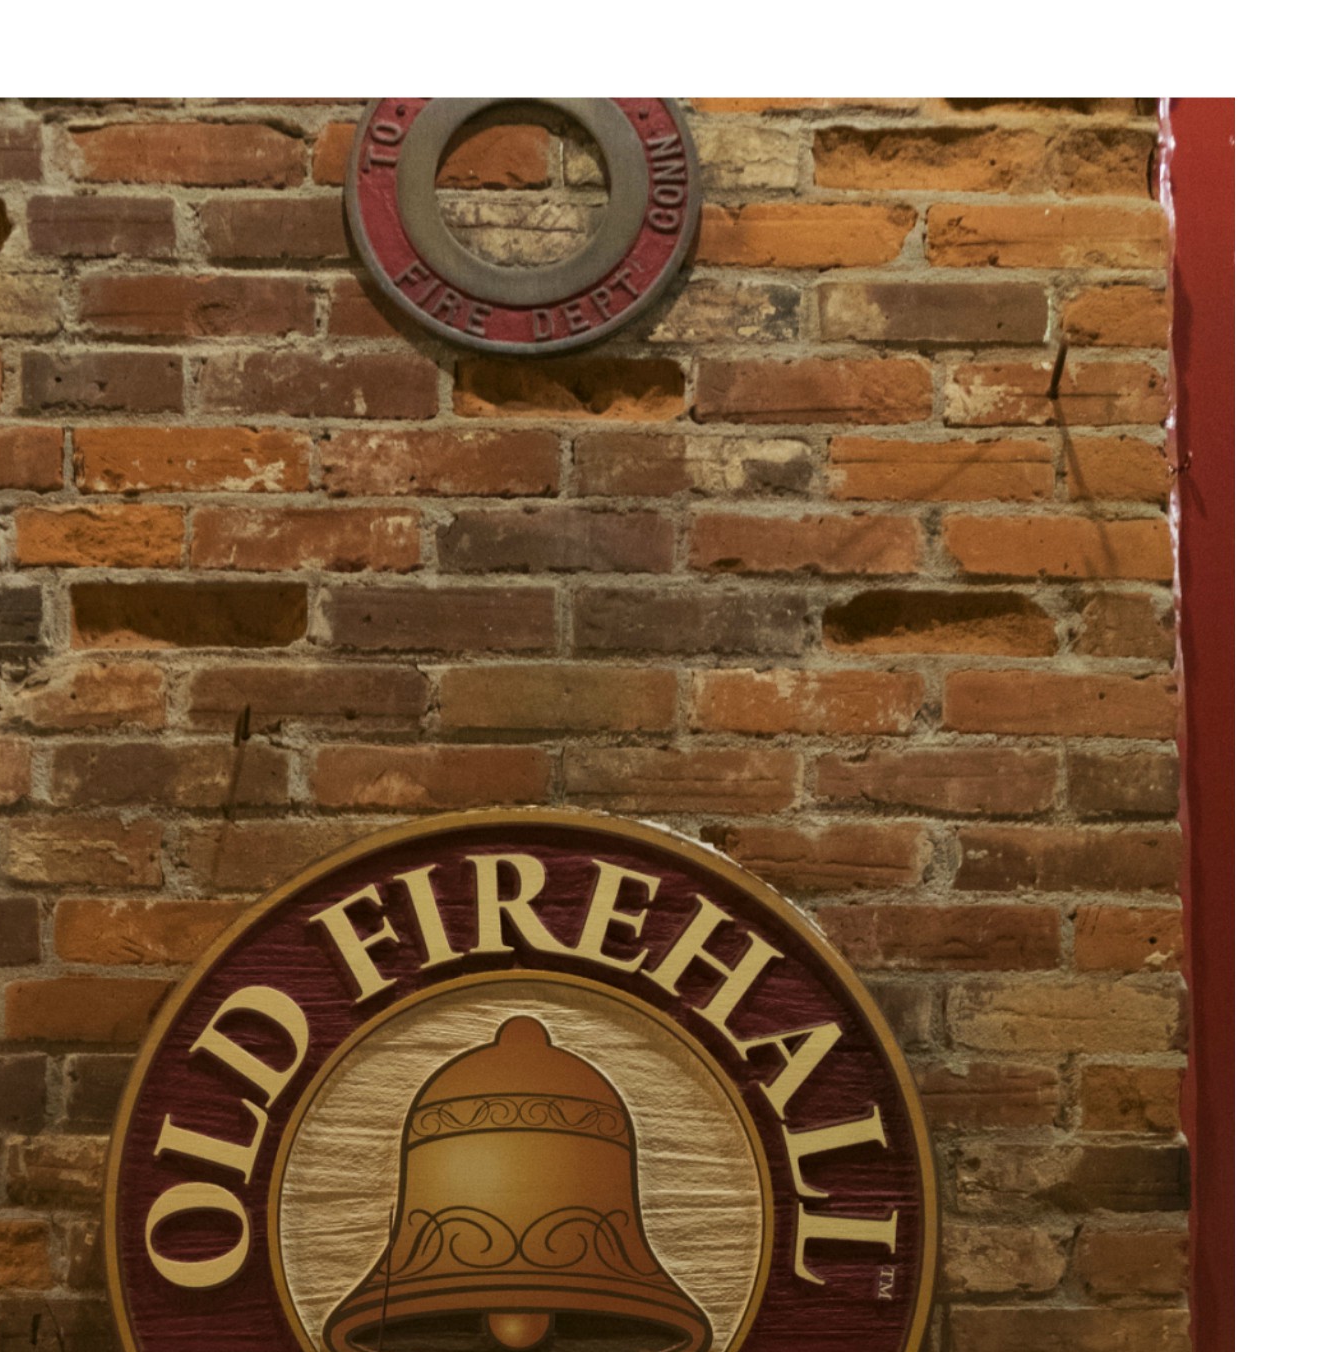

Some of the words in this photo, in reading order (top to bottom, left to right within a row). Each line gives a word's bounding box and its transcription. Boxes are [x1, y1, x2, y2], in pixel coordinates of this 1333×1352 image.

[393, 260, 492, 338] FIRE
[647, 133, 687, 235] CONN
[145, 985, 311, 1289] OLD
[307, 852, 900, 1286] FIREHALL
